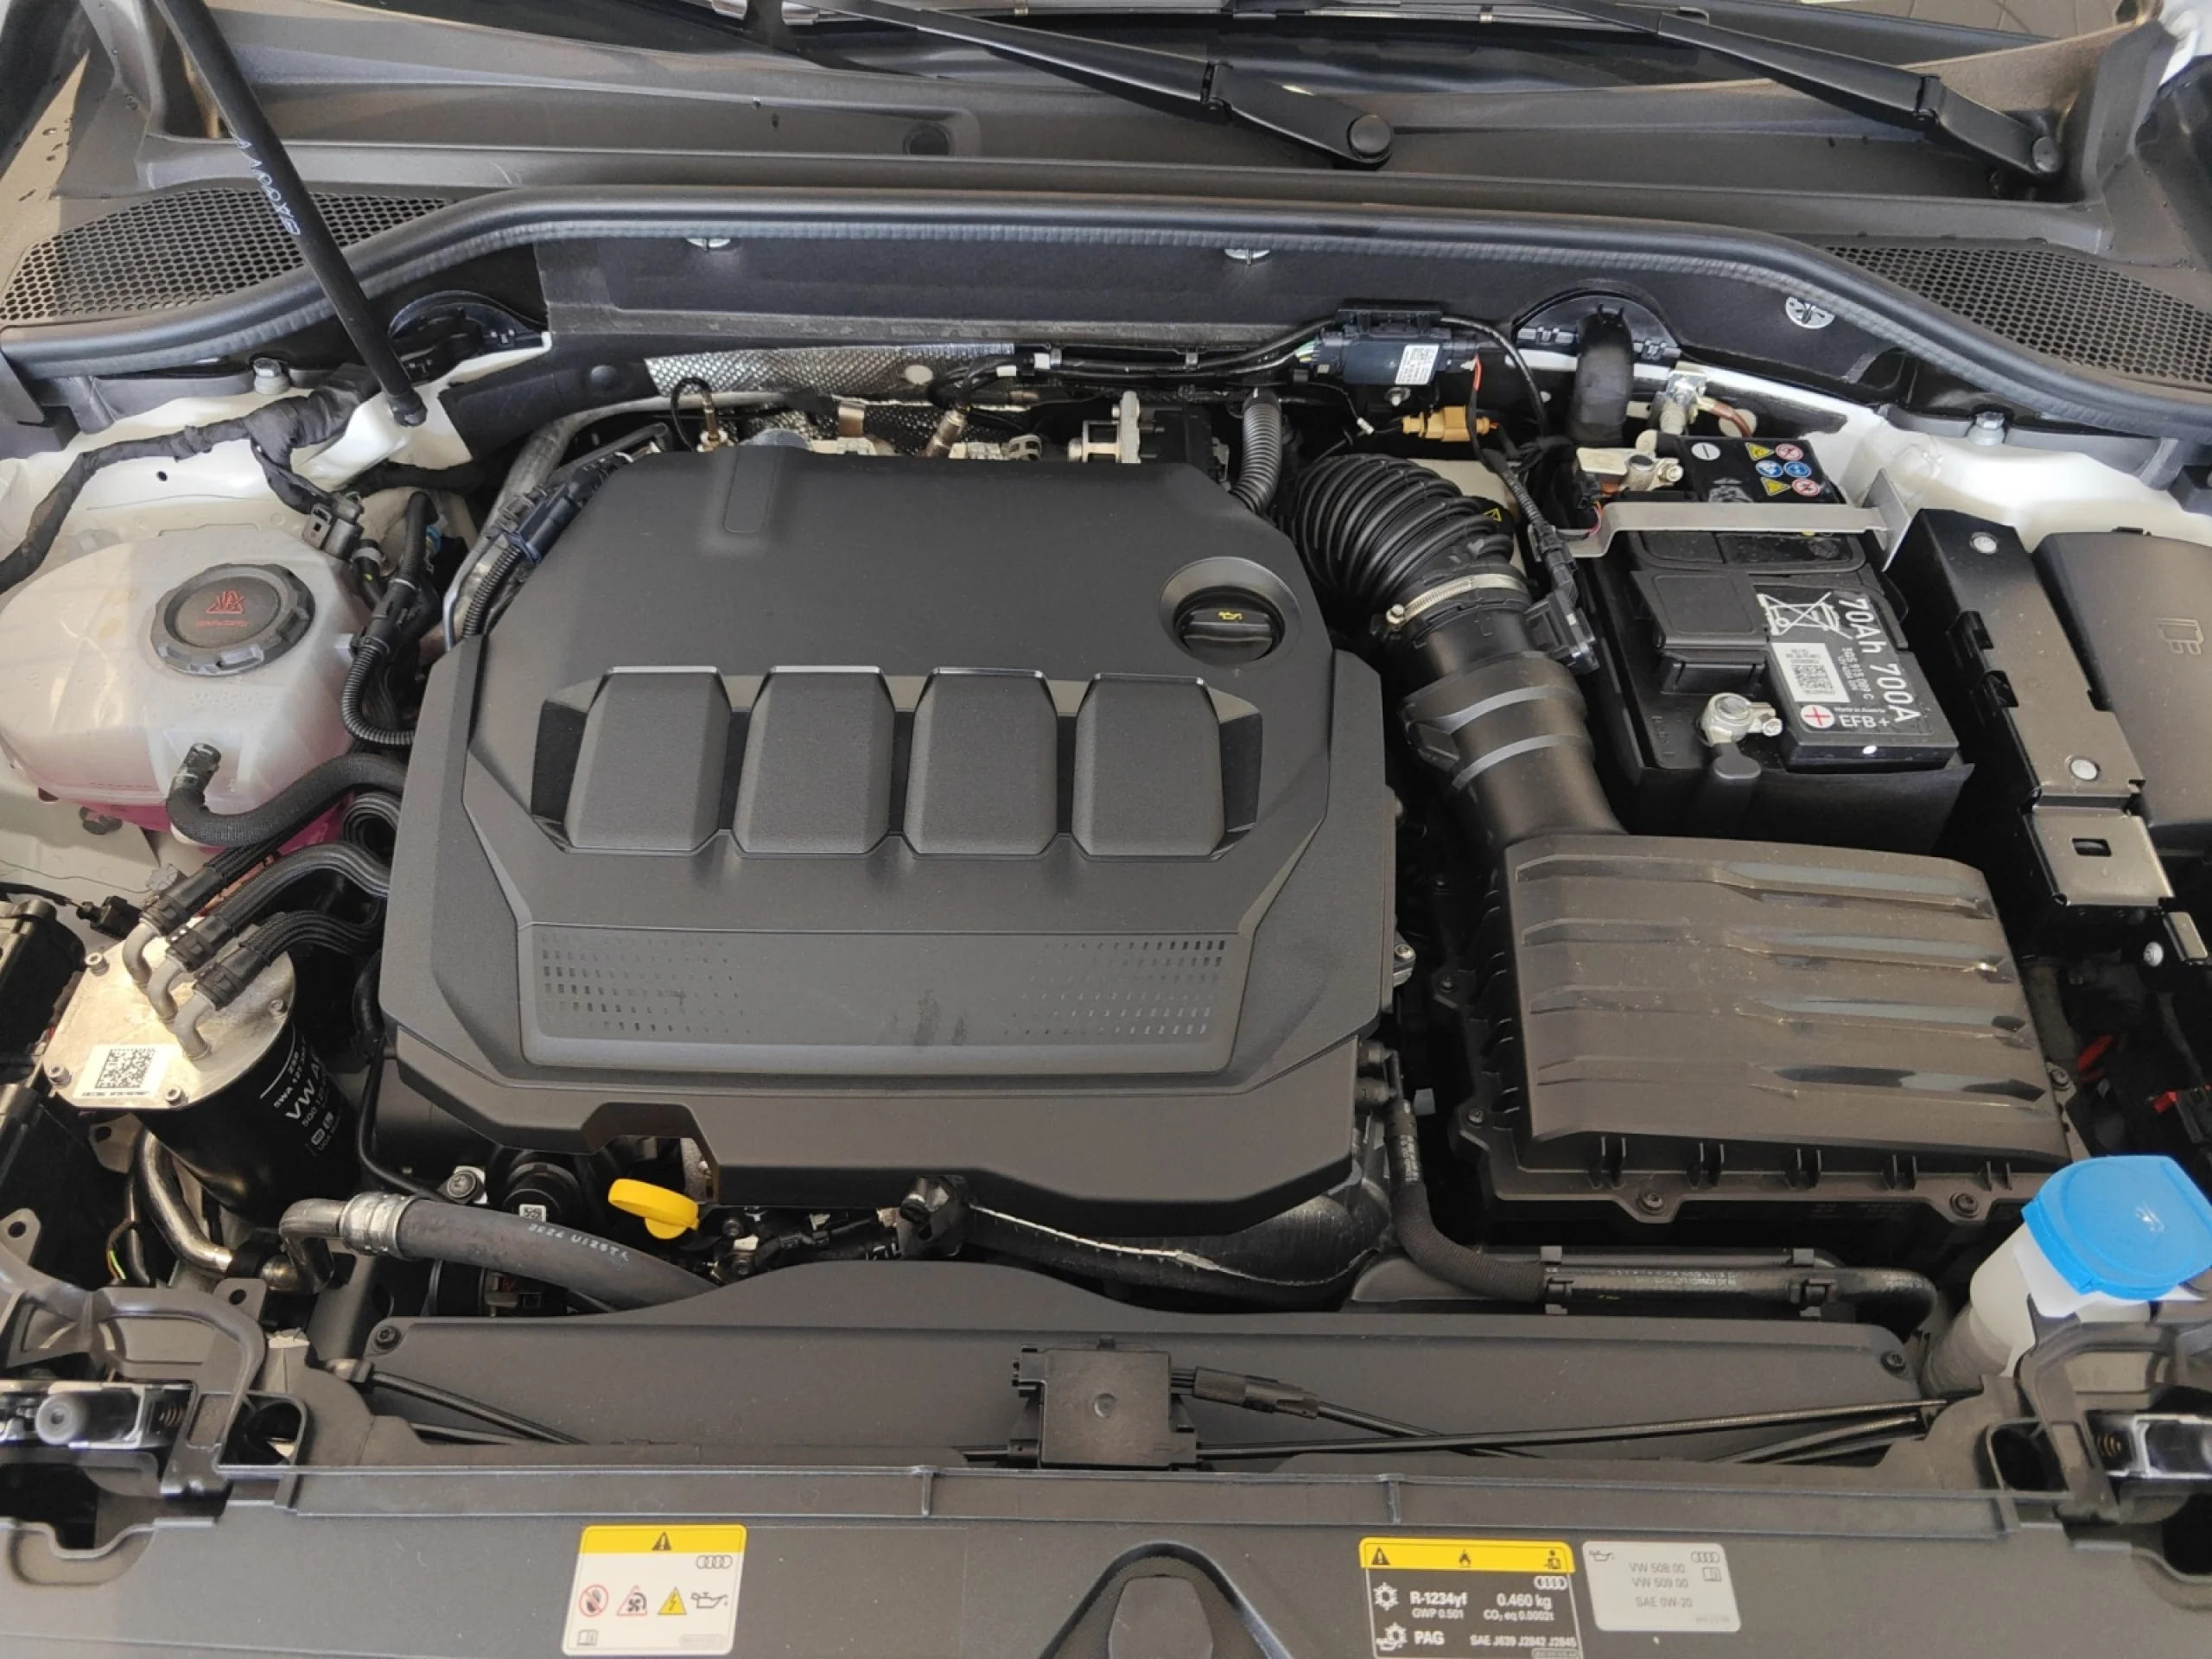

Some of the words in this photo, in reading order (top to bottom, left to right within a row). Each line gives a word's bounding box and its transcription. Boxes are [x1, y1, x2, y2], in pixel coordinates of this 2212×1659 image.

[1839, 598, 1887, 653] 70Ah
[1869, 664, 1921, 722] 700A
[285, 1078, 315, 1119] VW
[1629, 1562, 1649, 1573] VW
[1673, 1563, 1686, 1573] 00
[1631, 1577, 1651, 1587] VW
[1675, 1578, 1689, 1588] 00
[1410, 1591, 1467, 1608] R-1234yf
[1497, 1592, 1533, 1608] 0.460
[1535, 1593, 1552, 1610] kg
[1636, 1596, 1658, 1607] SAE
[1660, 1597, 1693, 1607] 0W-20
[1412, 1607, 1437, 1618] GWP
[1438, 1608, 1465, 1619] 0.501
[1414, 1630, 1446, 1646] PAG
[1470, 1634, 1491, 1646] SAE
